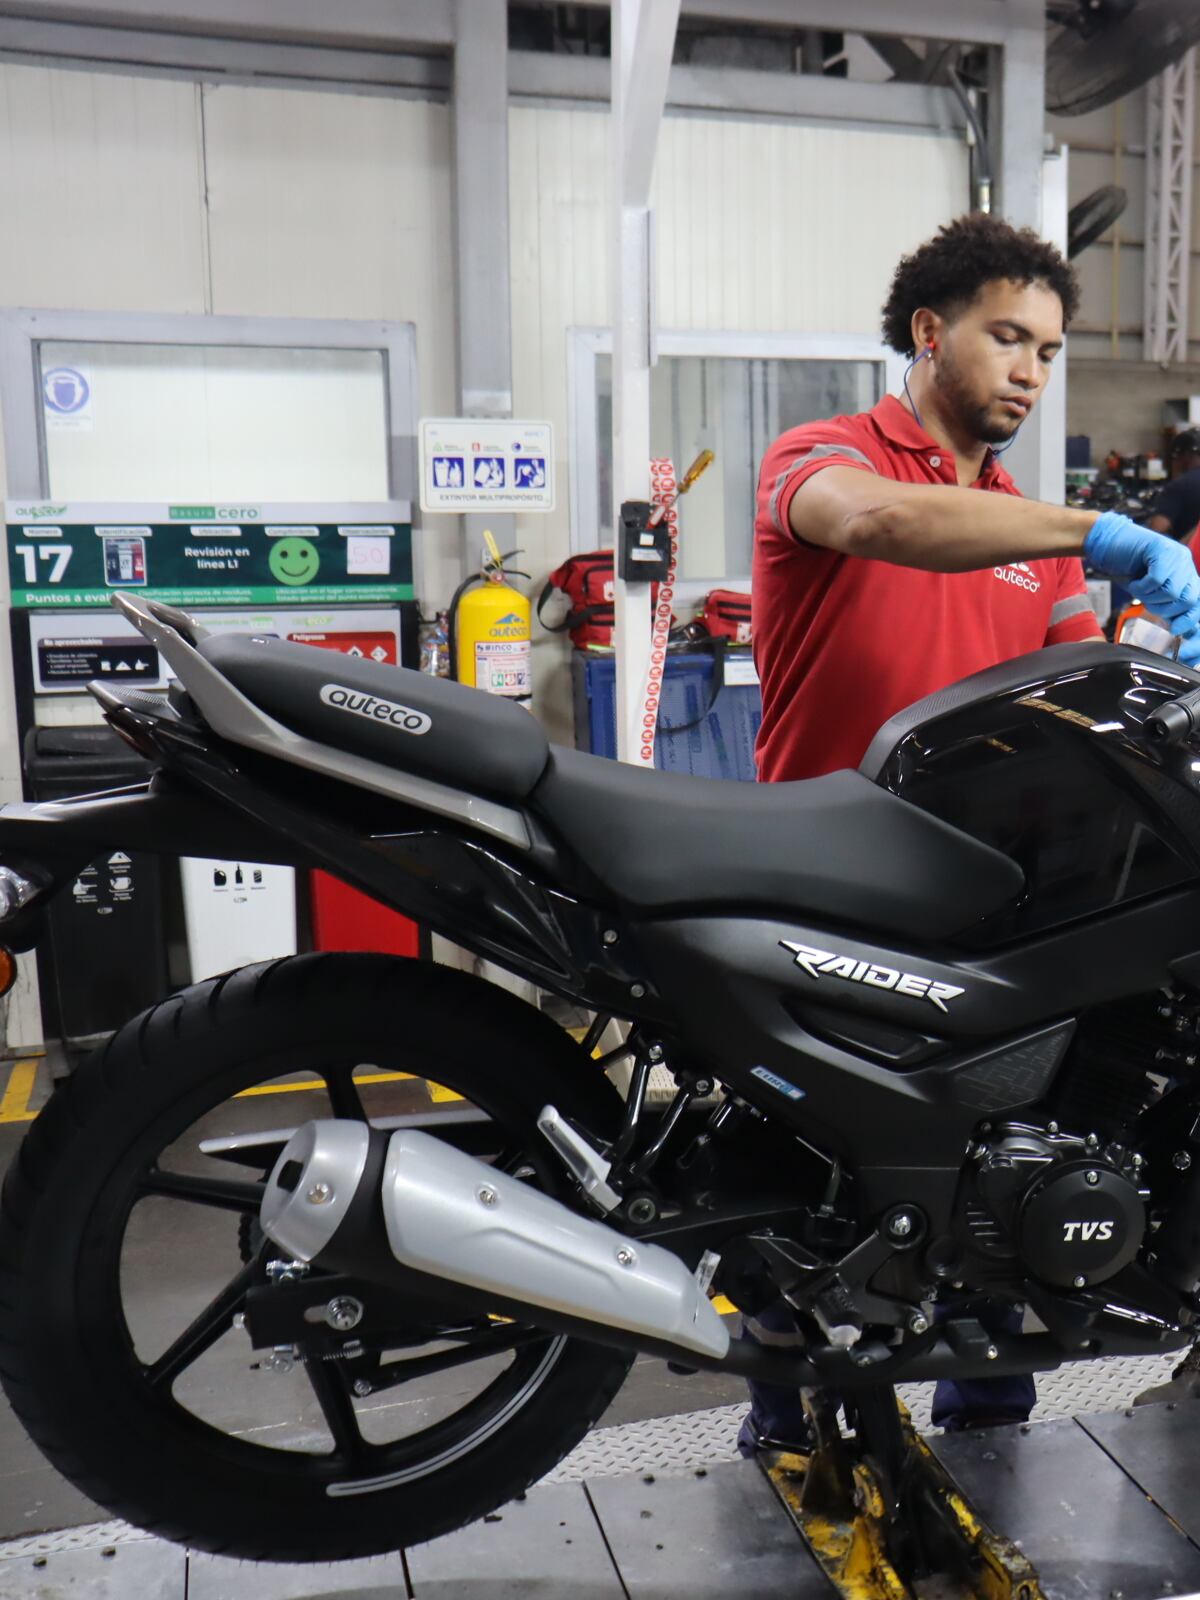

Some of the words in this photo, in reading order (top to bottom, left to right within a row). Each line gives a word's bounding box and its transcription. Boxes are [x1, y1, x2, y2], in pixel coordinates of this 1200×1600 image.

[218, 507, 258, 518] cero
[184, 546, 233, 557] Revisión
[235, 548, 250, 557] en
[15, 545, 73, 583] 17
[197, 558, 225, 569] línea
[994, 567, 1038, 592] auteco
[26, 593, 71, 603] Puntos
[74, 595, 82, 603] a
[84, 592, 111, 602] eval
[329, 690, 423, 729] auteco
[779, 940, 965, 1013] RAIDER
[1063, 1221, 1114, 1241] TVS
